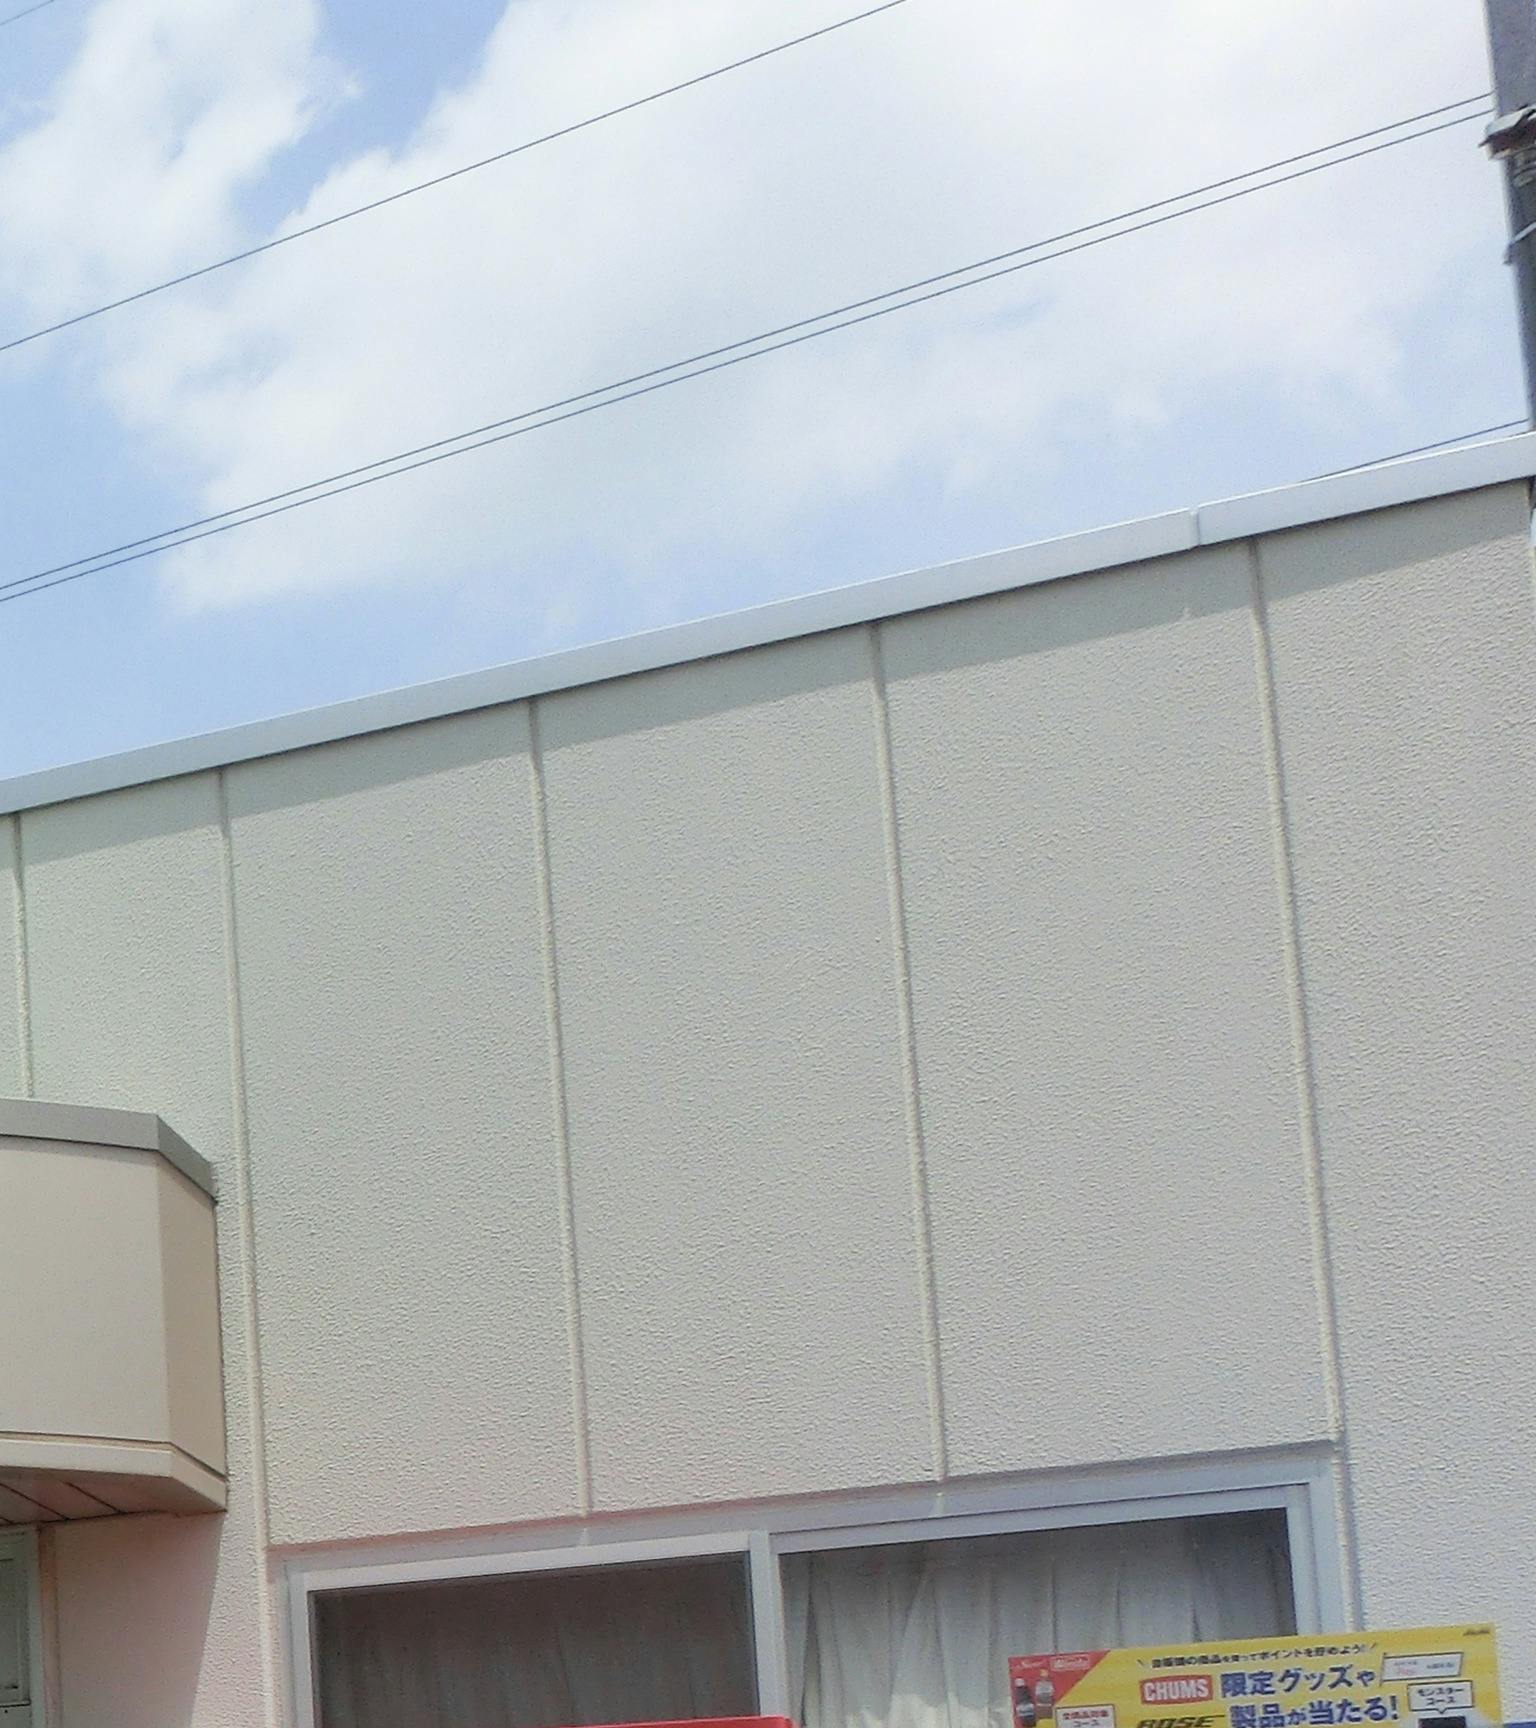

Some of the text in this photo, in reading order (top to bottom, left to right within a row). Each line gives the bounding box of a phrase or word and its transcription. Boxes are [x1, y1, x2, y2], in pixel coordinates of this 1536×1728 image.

[1143, 1679, 1209, 1702] CHUMS
[1220, 1664, 1375, 1698] 限定グッズや
